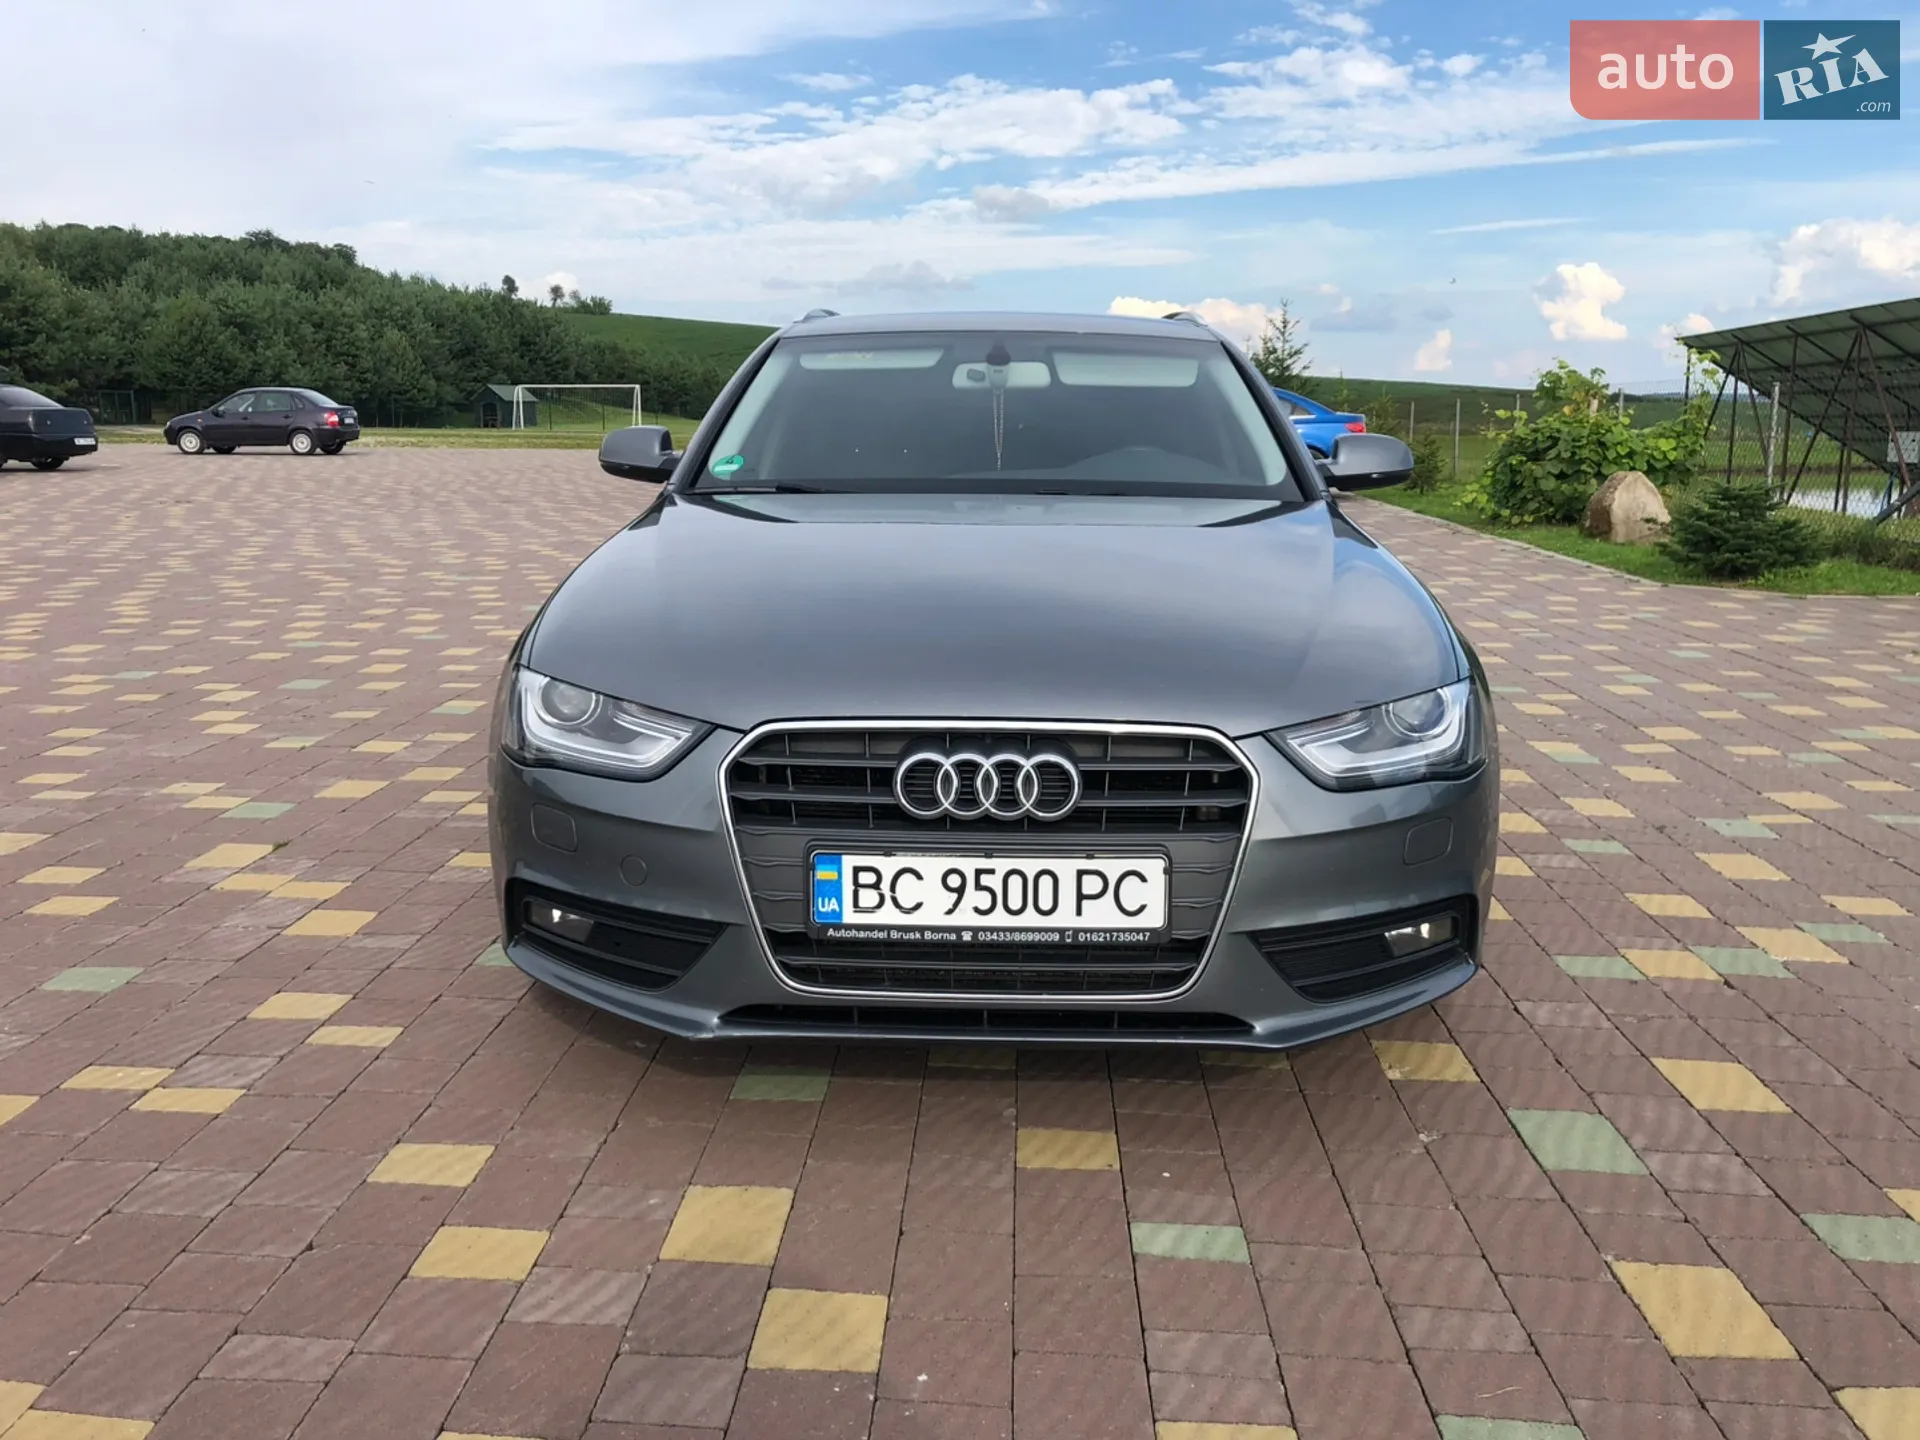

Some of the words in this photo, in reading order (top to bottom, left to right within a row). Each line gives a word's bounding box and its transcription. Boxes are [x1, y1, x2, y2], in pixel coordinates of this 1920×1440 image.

[852, 865, 924, 914] BC
[940, 867, 1059, 917] 9500
[1075, 868, 1148, 917] PC
[818, 897, 840, 912] UA
[827, 928, 888, 939] Autohandel
[890, 929, 921, 940] Brusk
[924, 930, 957, 941] Borna
[978, 931, 1060, 943] 03433/8699009
[1078, 931, 1151, 943] 01621735047
